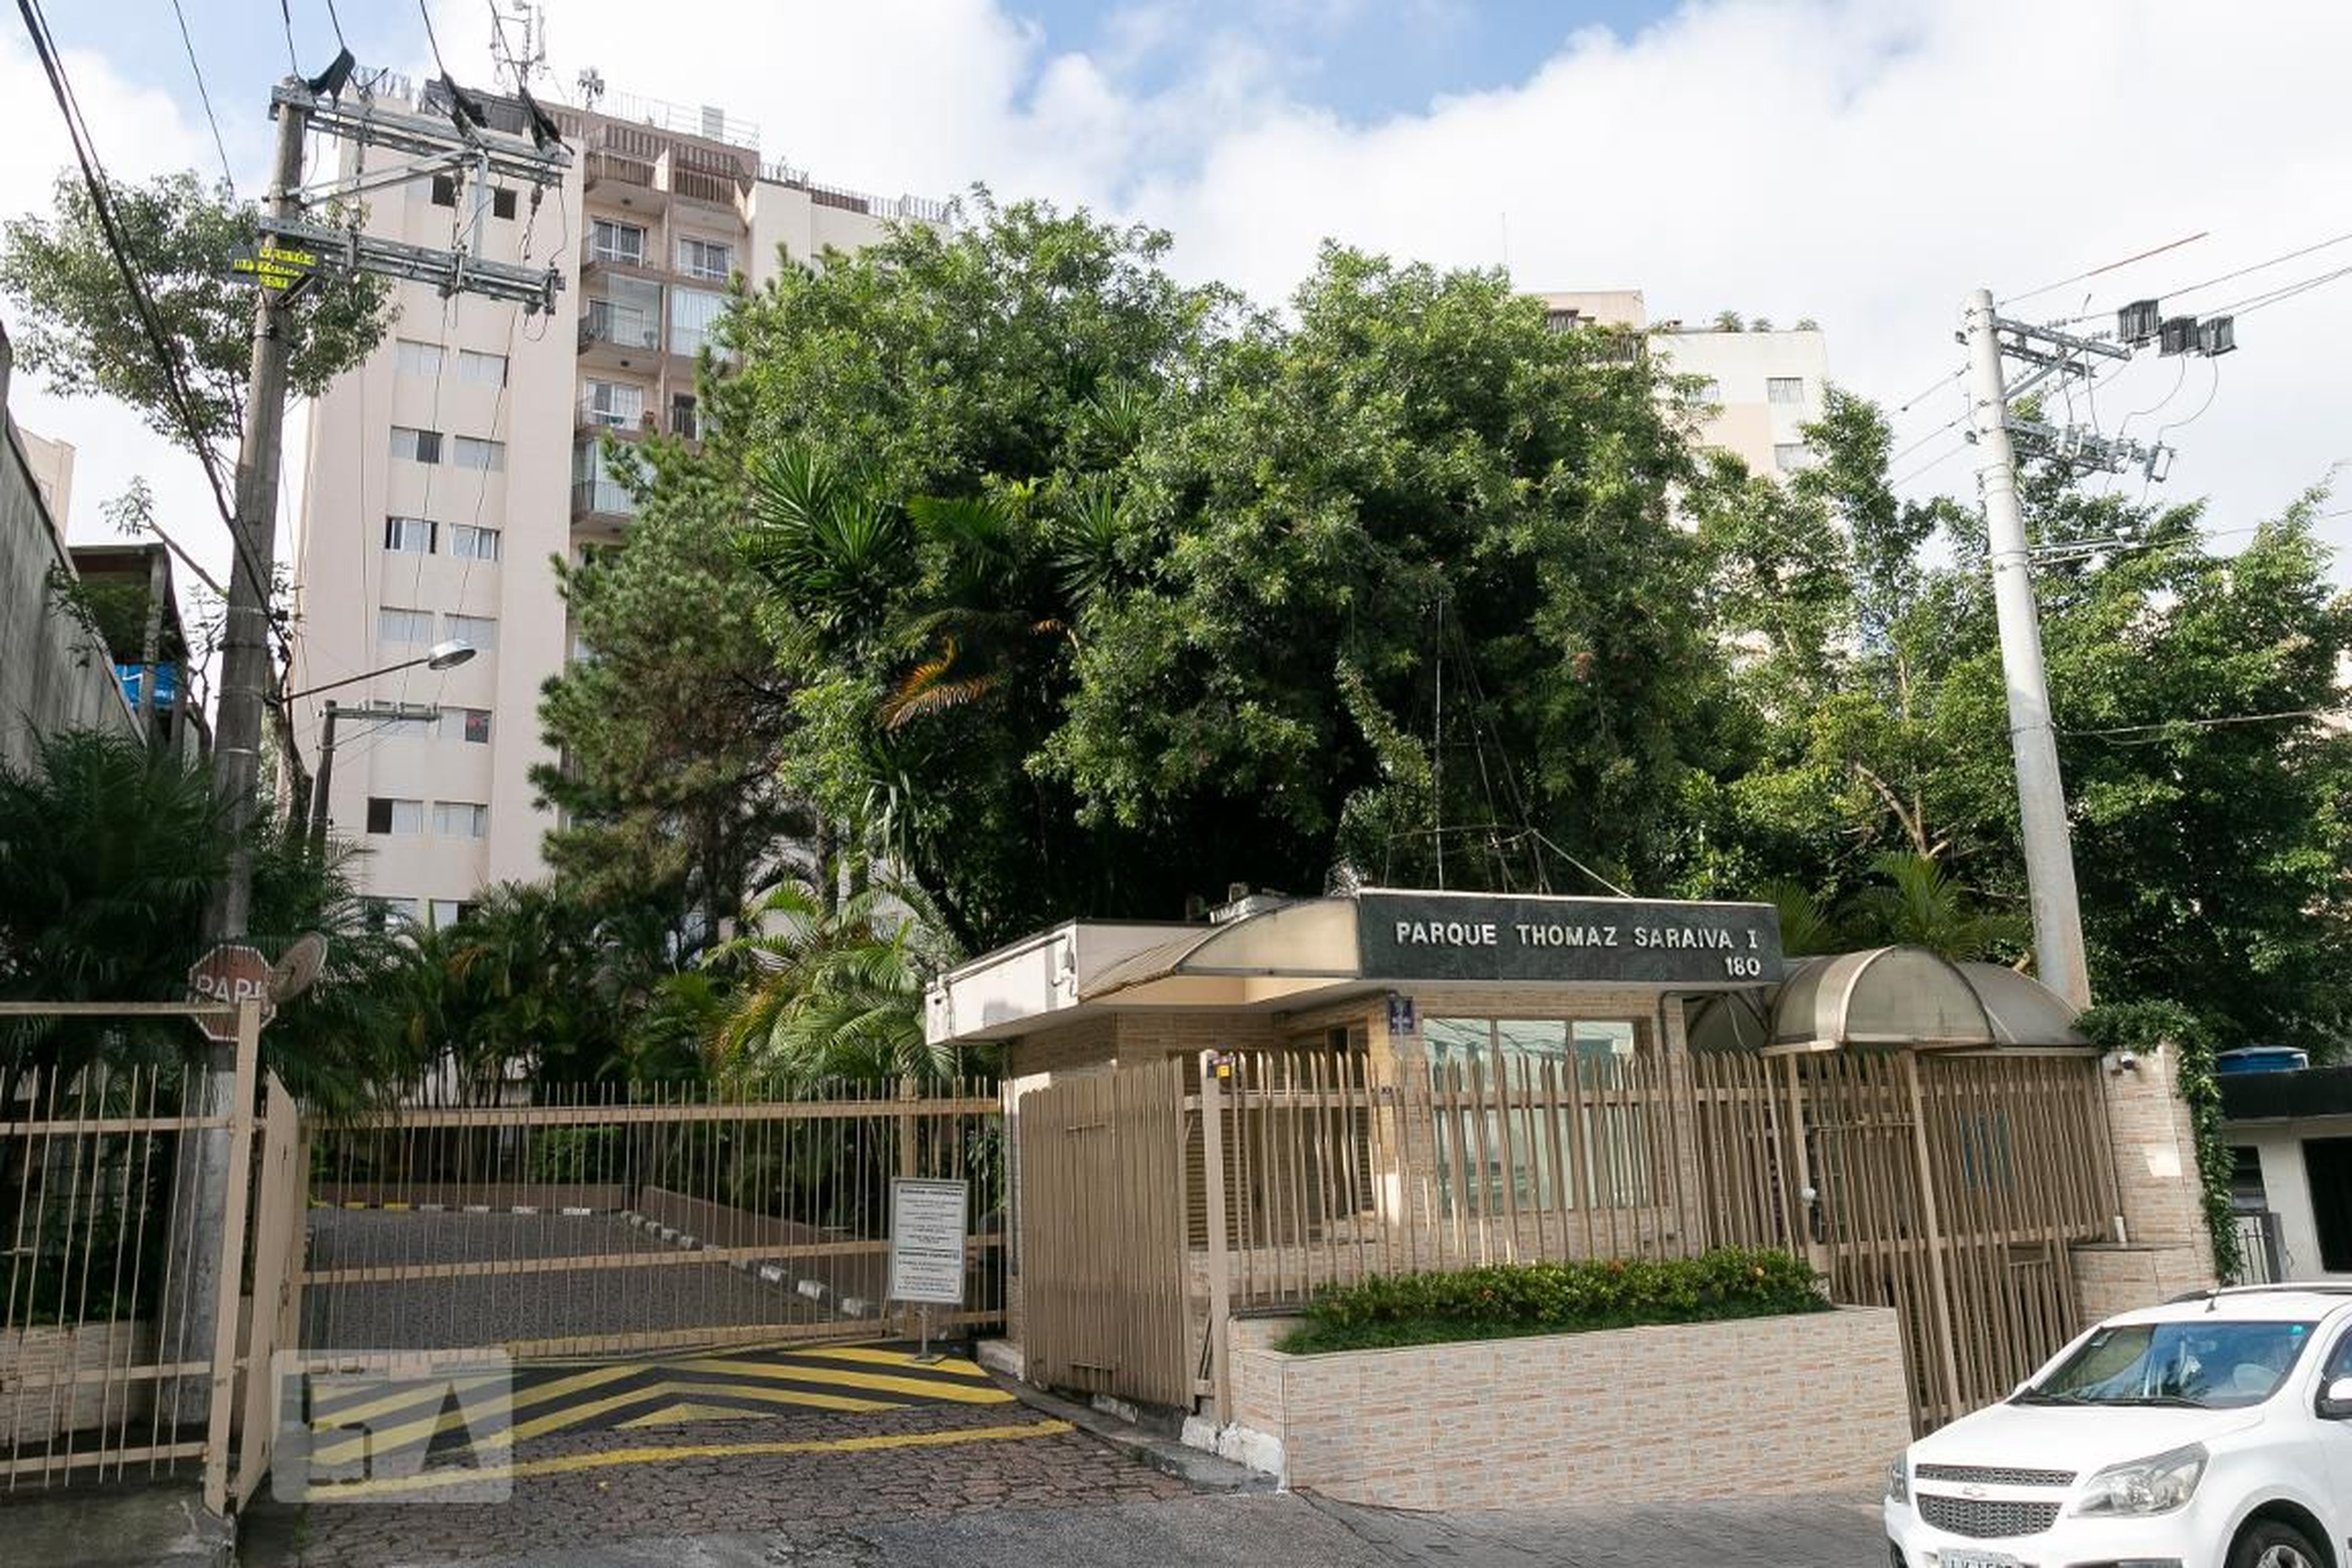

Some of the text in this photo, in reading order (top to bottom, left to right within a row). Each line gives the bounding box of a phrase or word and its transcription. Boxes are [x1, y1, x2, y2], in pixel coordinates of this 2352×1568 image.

[1395, 921, 1758, 949] PARQUE THOMAZ SARAIVA I
[1724, 956, 1761, 976] 180
